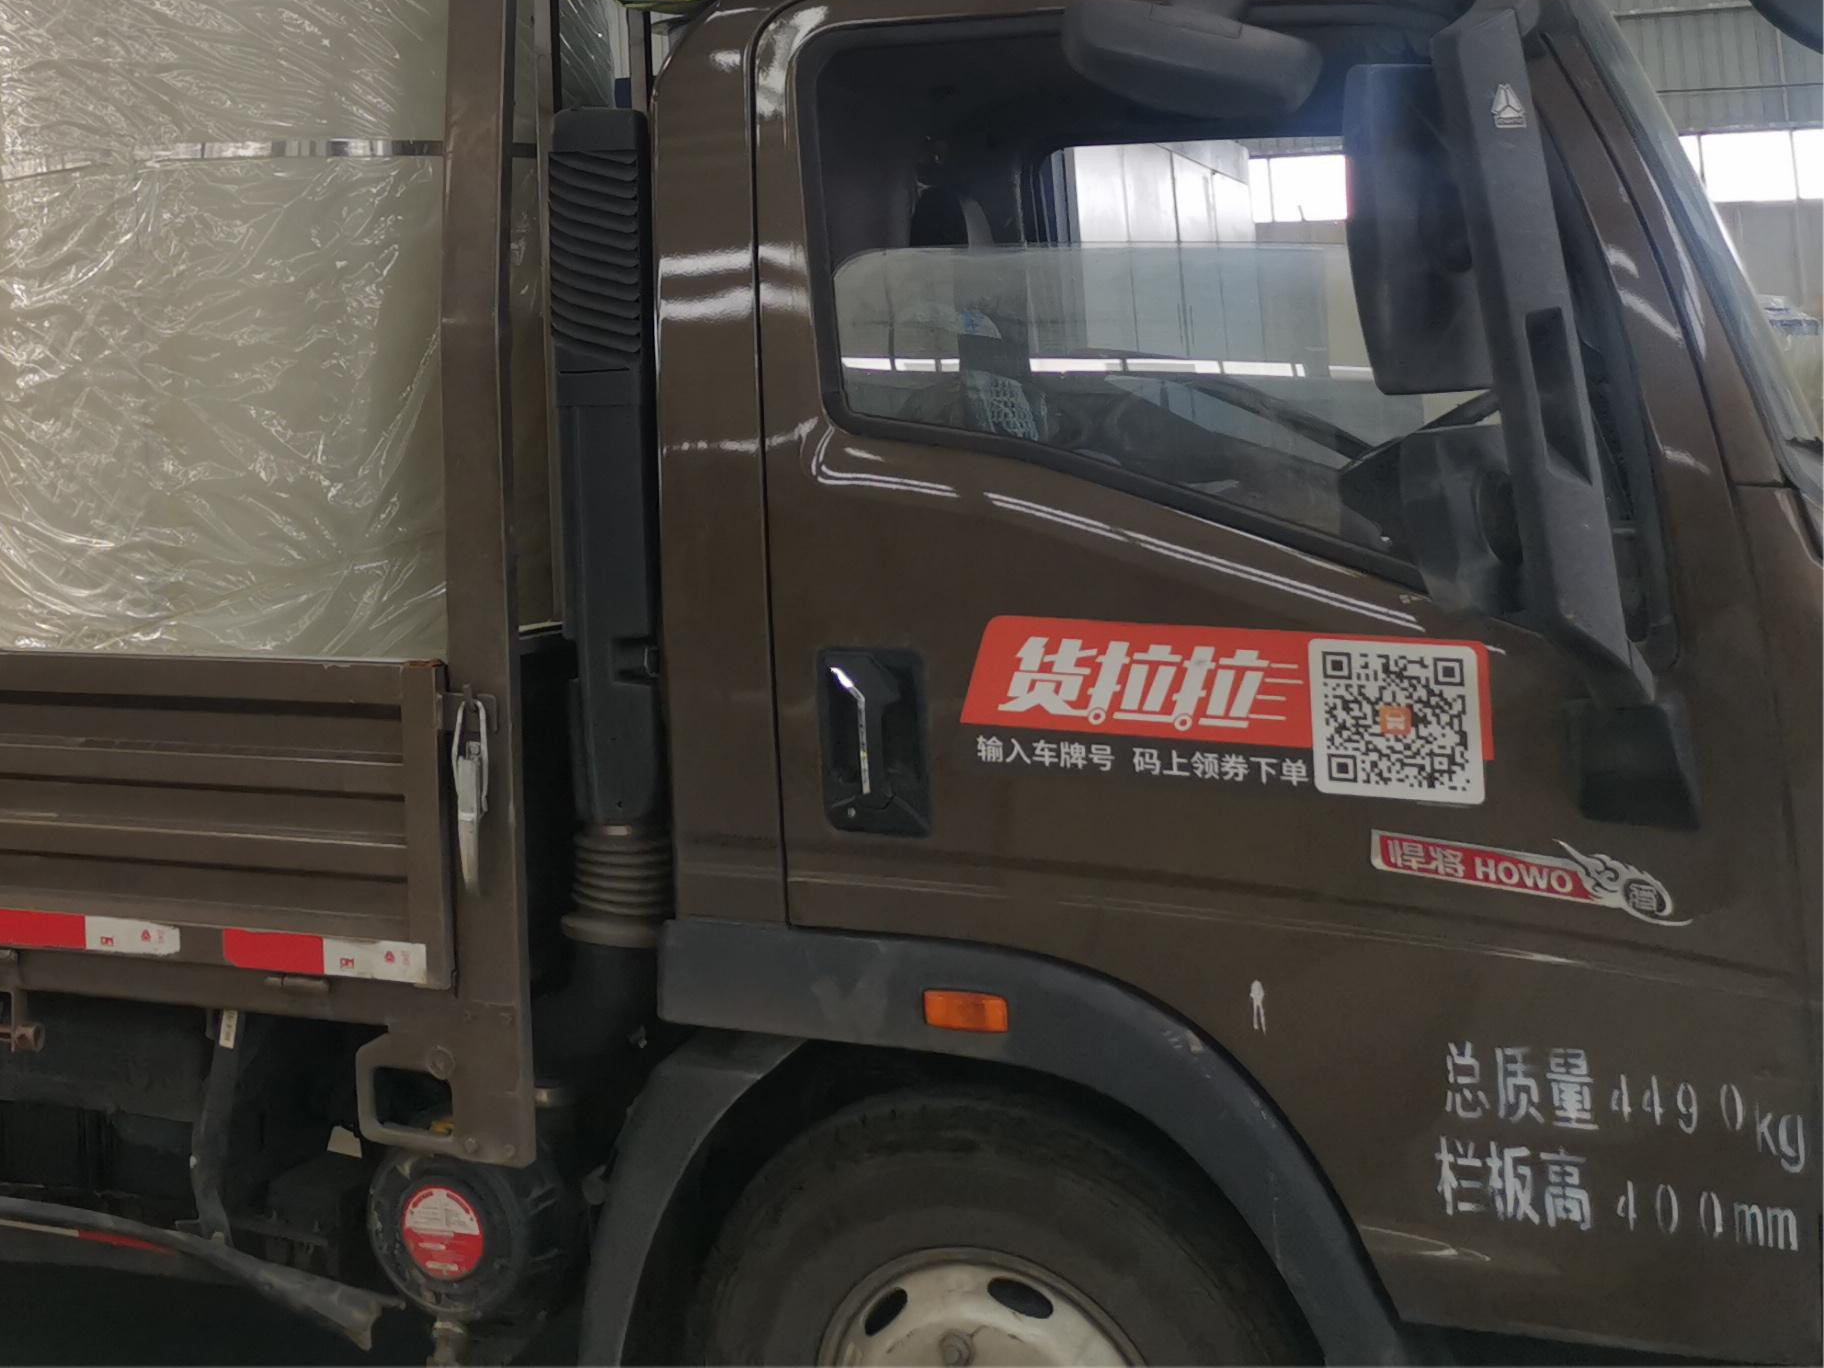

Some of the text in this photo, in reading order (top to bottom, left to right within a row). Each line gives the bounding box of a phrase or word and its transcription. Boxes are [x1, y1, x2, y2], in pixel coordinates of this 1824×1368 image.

[998, 636, 1274, 731] 货拉拉
[976, 735, 1310, 786] 输入车牌号 码上领券下单
[1387, 840, 1573, 894] 悍将 HOWO
